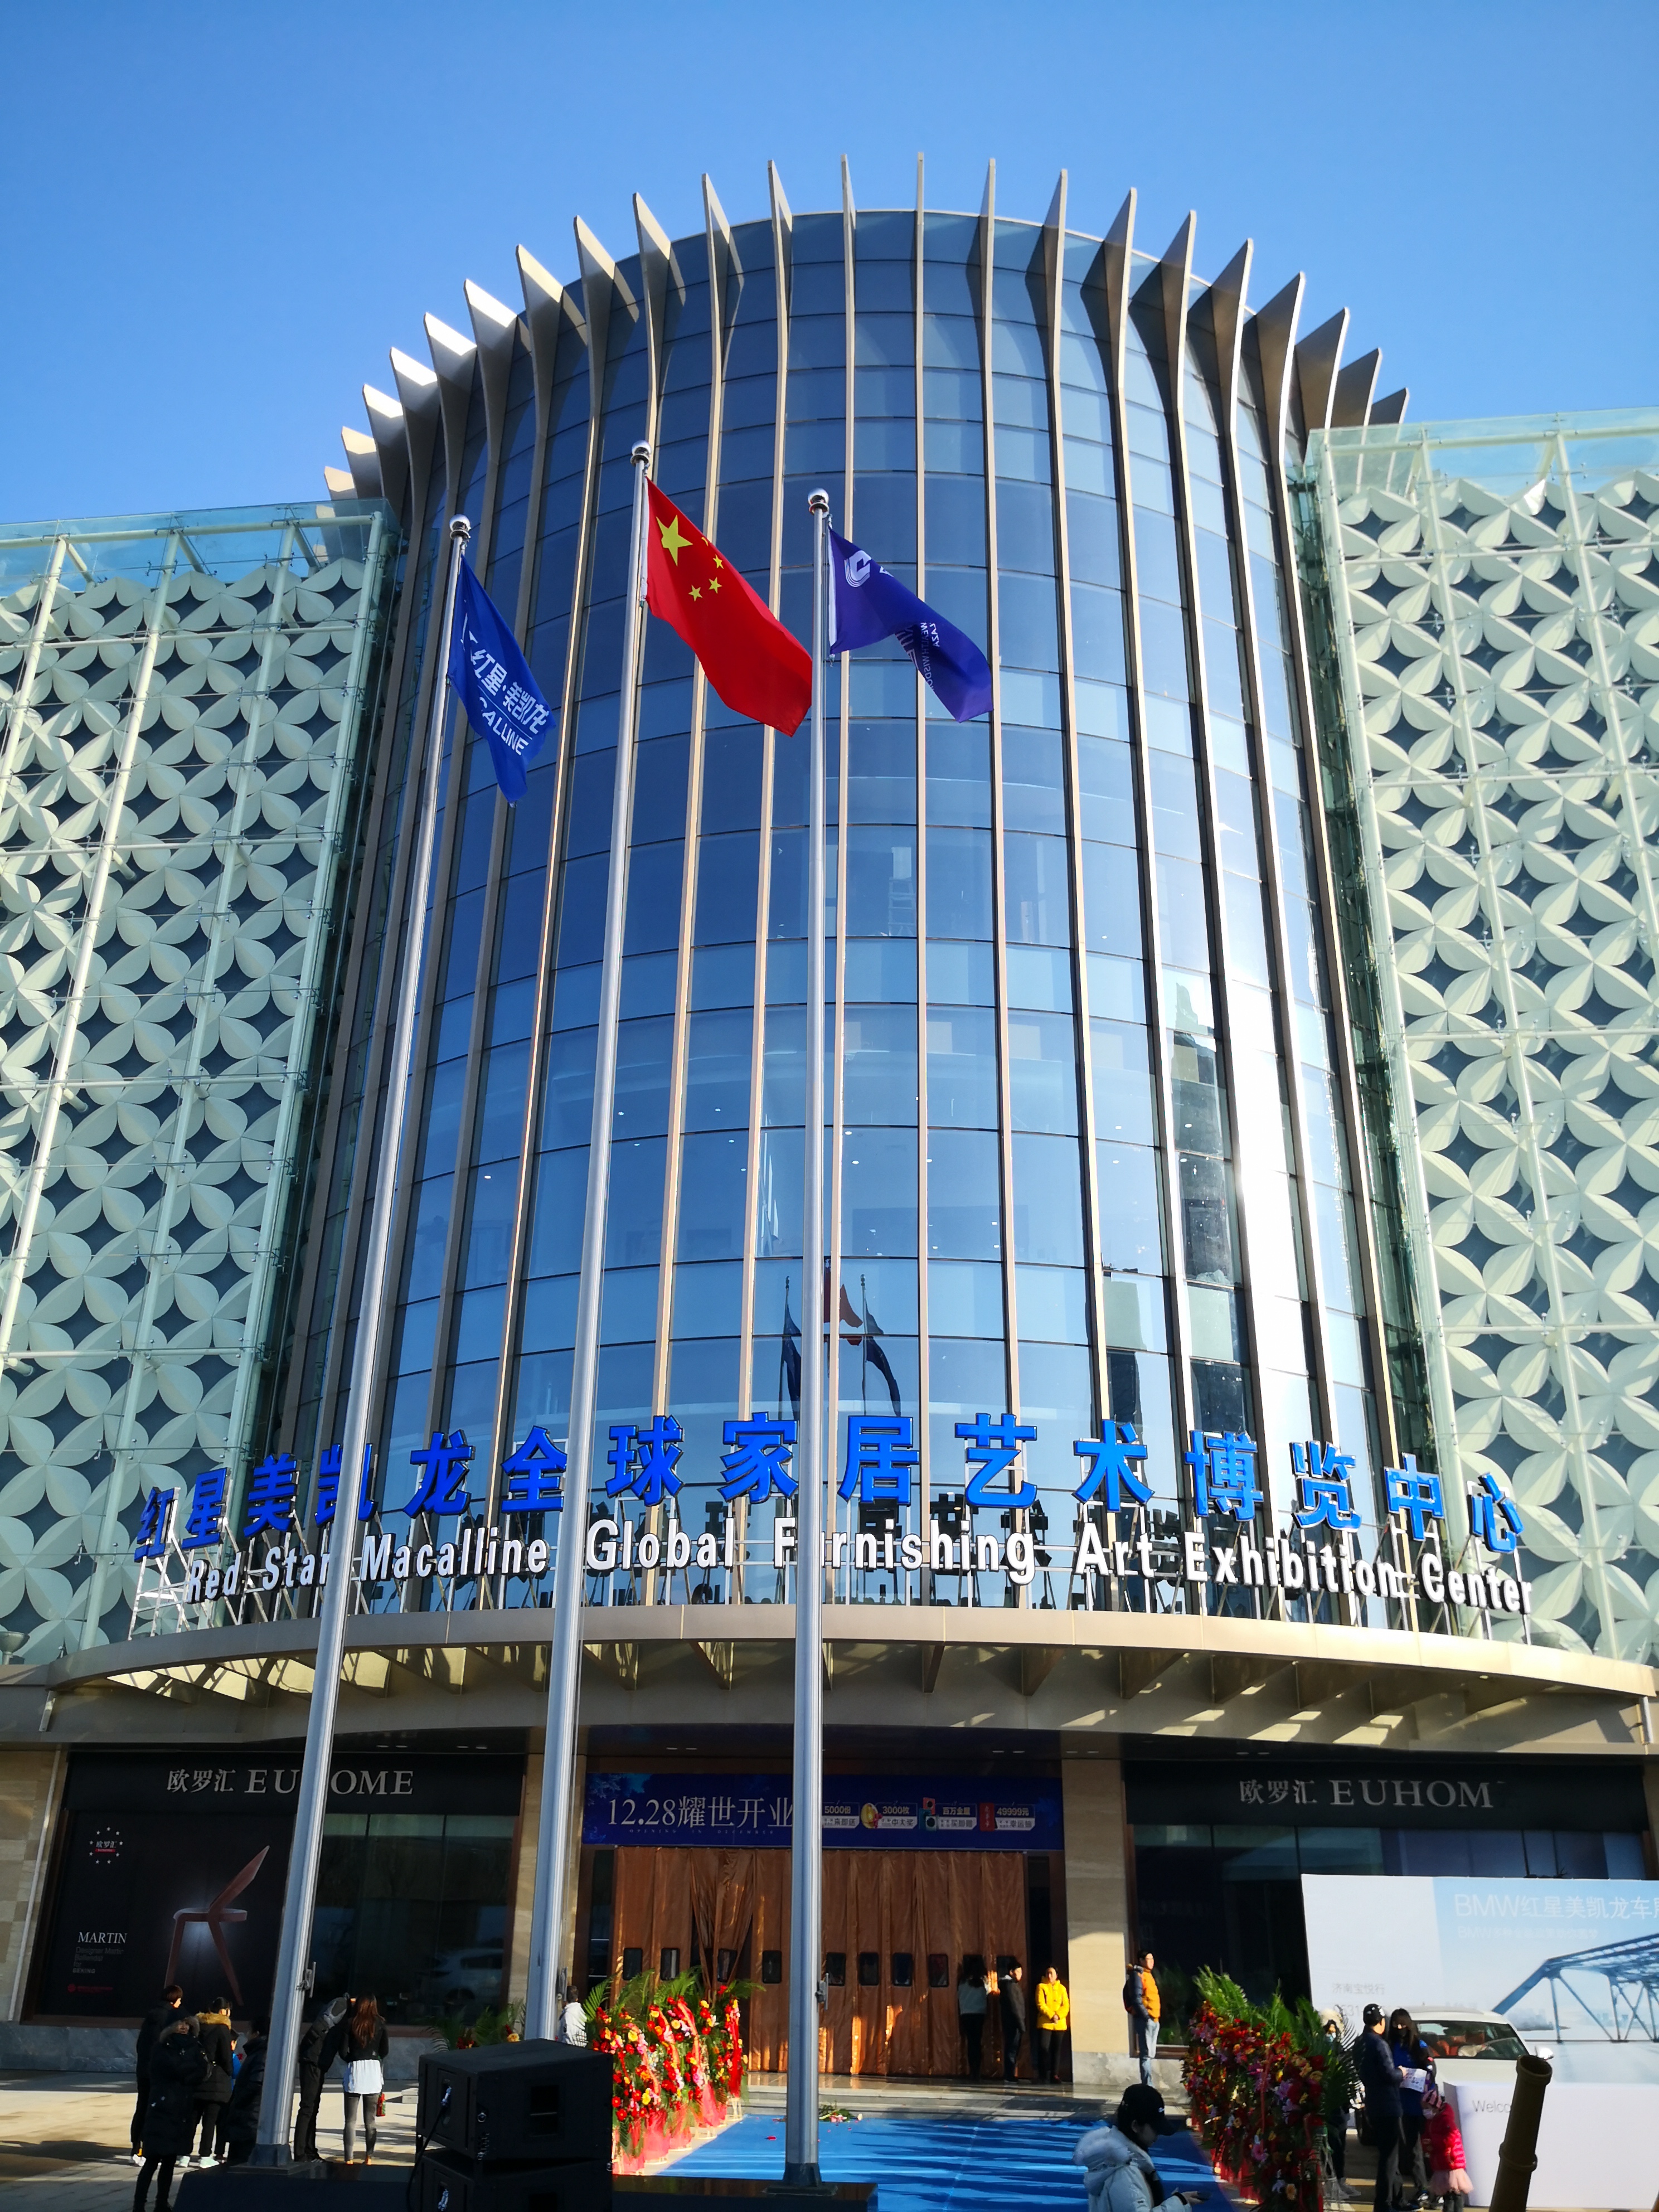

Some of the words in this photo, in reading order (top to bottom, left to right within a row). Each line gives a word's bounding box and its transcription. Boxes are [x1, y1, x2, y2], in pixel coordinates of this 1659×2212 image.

[134, 1412, 1525, 1561] 红星美凯龙全球家居艺术博览中心
[187, 1553, 240, 1604] Red
[263, 1546, 331, 1591] Star
[361, 1526, 549, 1582] Macalline
[586, 1517, 734, 1571] Global
[773, 1517, 1036, 1585] Frnishing
[1075, 1522, 1155, 1579] Art
[1185, 1532, 1397, 1598] Exhibition
[1422, 1553, 1532, 1614] Center
[167, 1768, 236, 1793] 欧罗汇
[245, 1769, 414, 1794] EUOME
[1239, 1779, 1317, 1806] 欧罗汇
[1330, 1779, 1506, 1808] EUHOM
[77, 1932, 128, 1944] MARTIN
